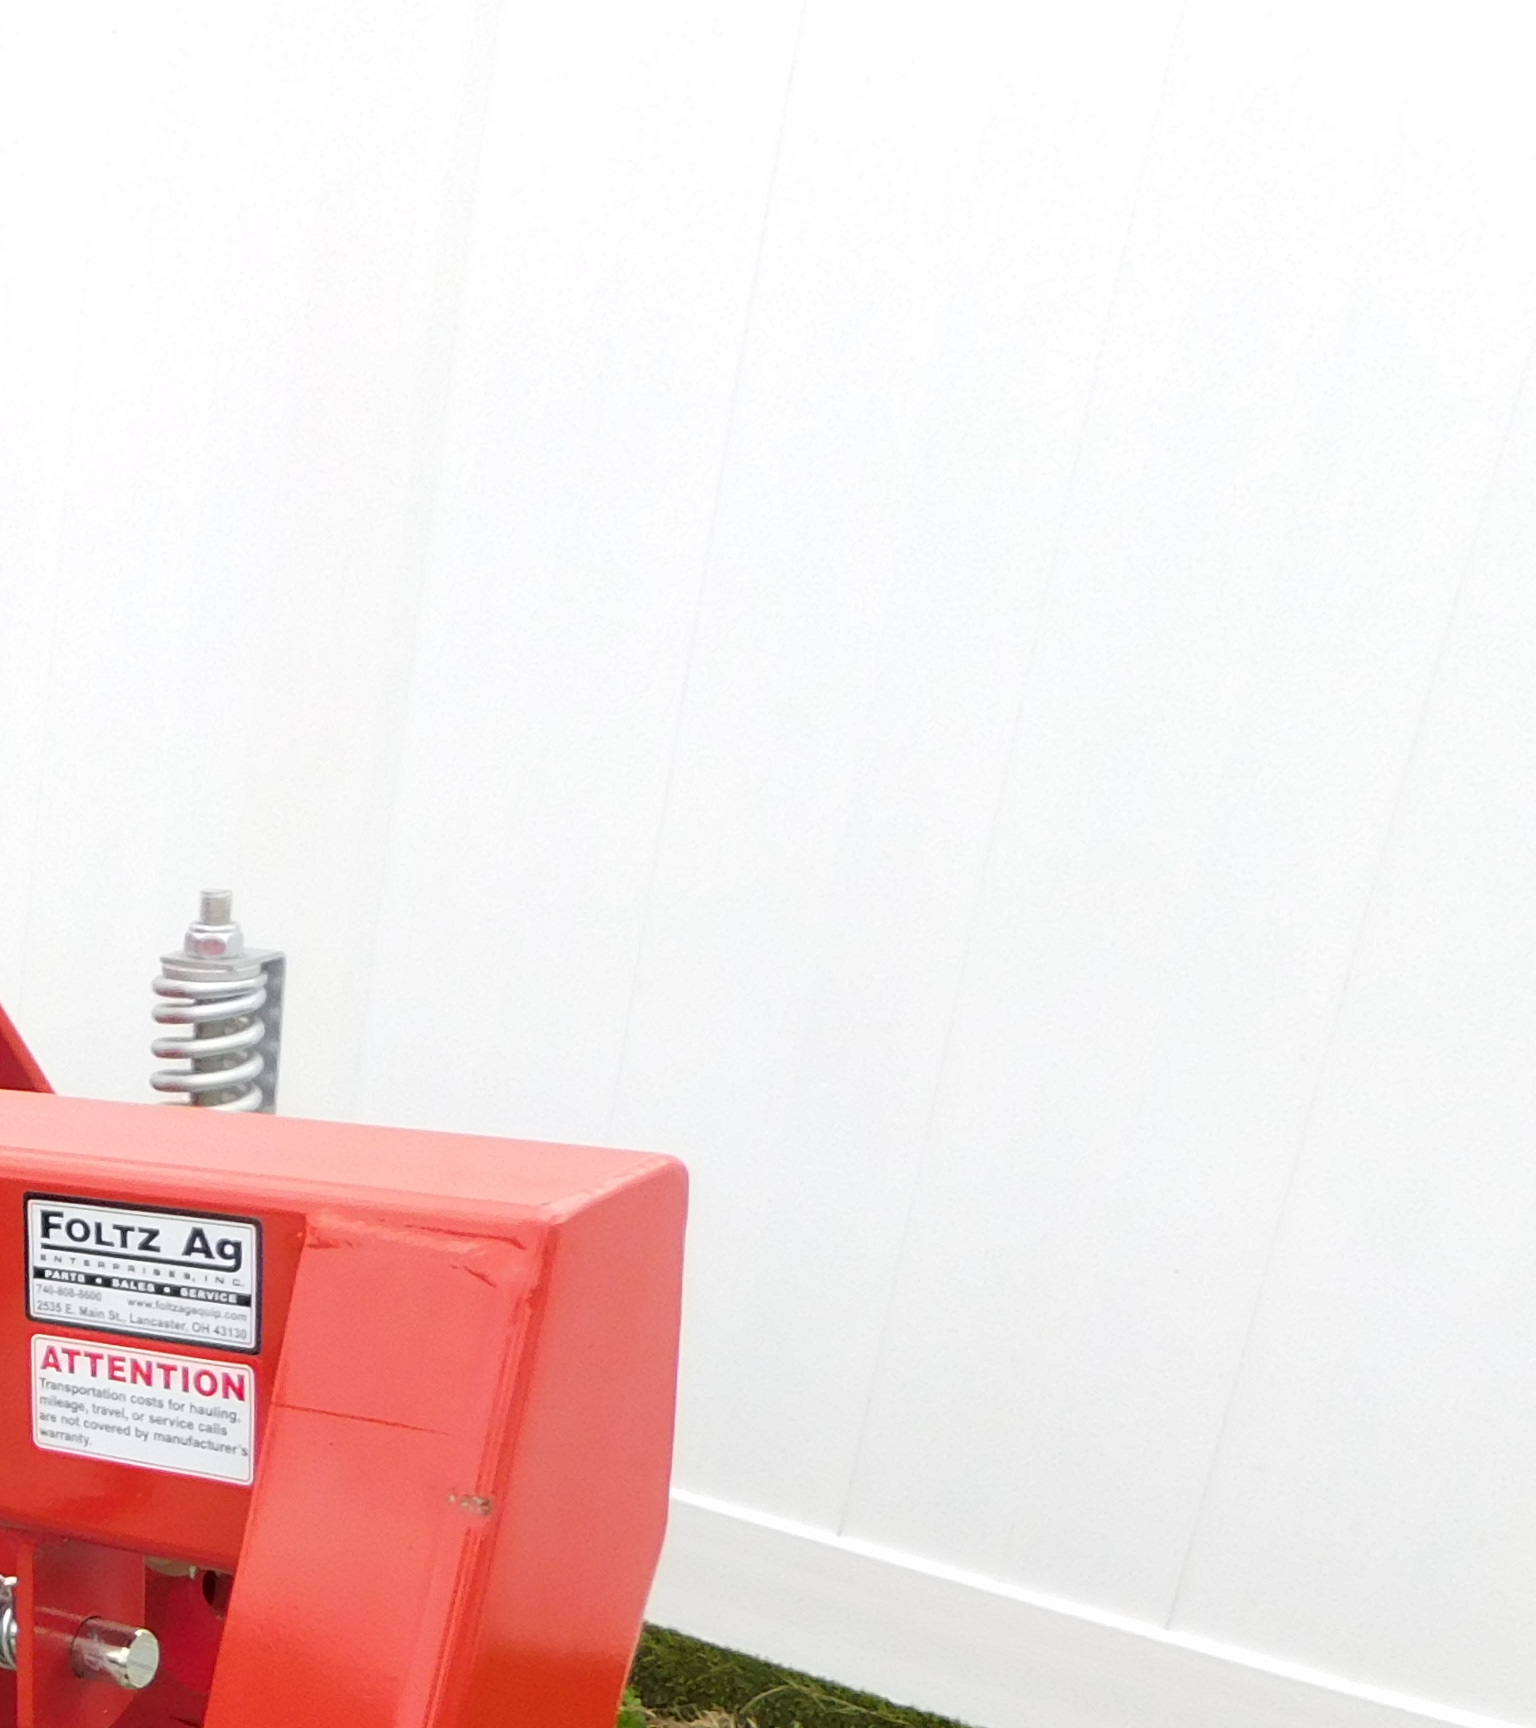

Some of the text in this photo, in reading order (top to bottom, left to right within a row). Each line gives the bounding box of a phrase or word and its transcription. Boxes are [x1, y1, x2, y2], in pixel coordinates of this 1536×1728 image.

[39, 1209, 243, 1272] FOLTZ Ag
[44, 1269, 238, 1304] PARTS SALES SERVICE
[79, 1306, 105, 1319] Main
[192, 1322, 210, 1334] OH
[213, 1326, 247, 1340] 43130
[40, 1345, 245, 1401] ATTENTION
[39, 1377, 126, 1402] Transportation
[130, 1395, 164, 1409] costs
[168, 1399, 185, 1411] for
[39, 1395, 228, 1436] mileage, travel, or service calls
[39, 1412, 248, 1457] are not covered by manufacturer's
